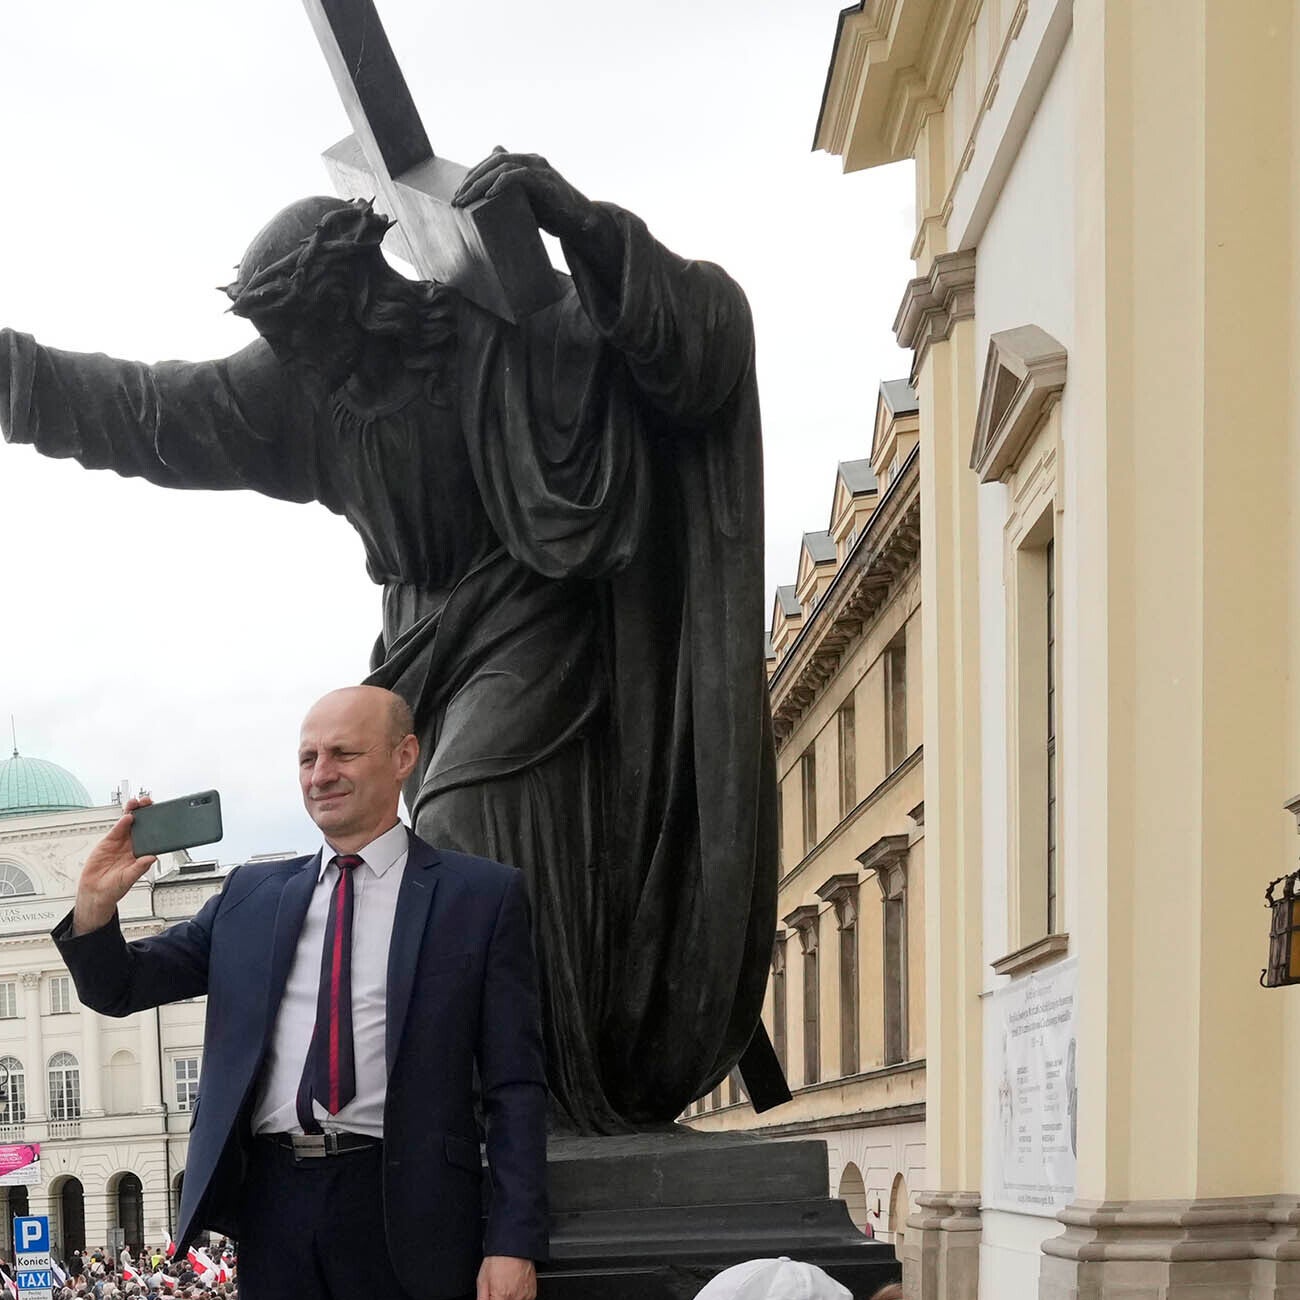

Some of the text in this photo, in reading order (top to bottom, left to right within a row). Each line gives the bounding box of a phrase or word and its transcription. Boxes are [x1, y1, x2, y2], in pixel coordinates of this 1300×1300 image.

[22, 1220, 42, 1249] P
[18, 1257, 49, 1266] Koniec
[18, 1273, 50, 1288] TAXI
